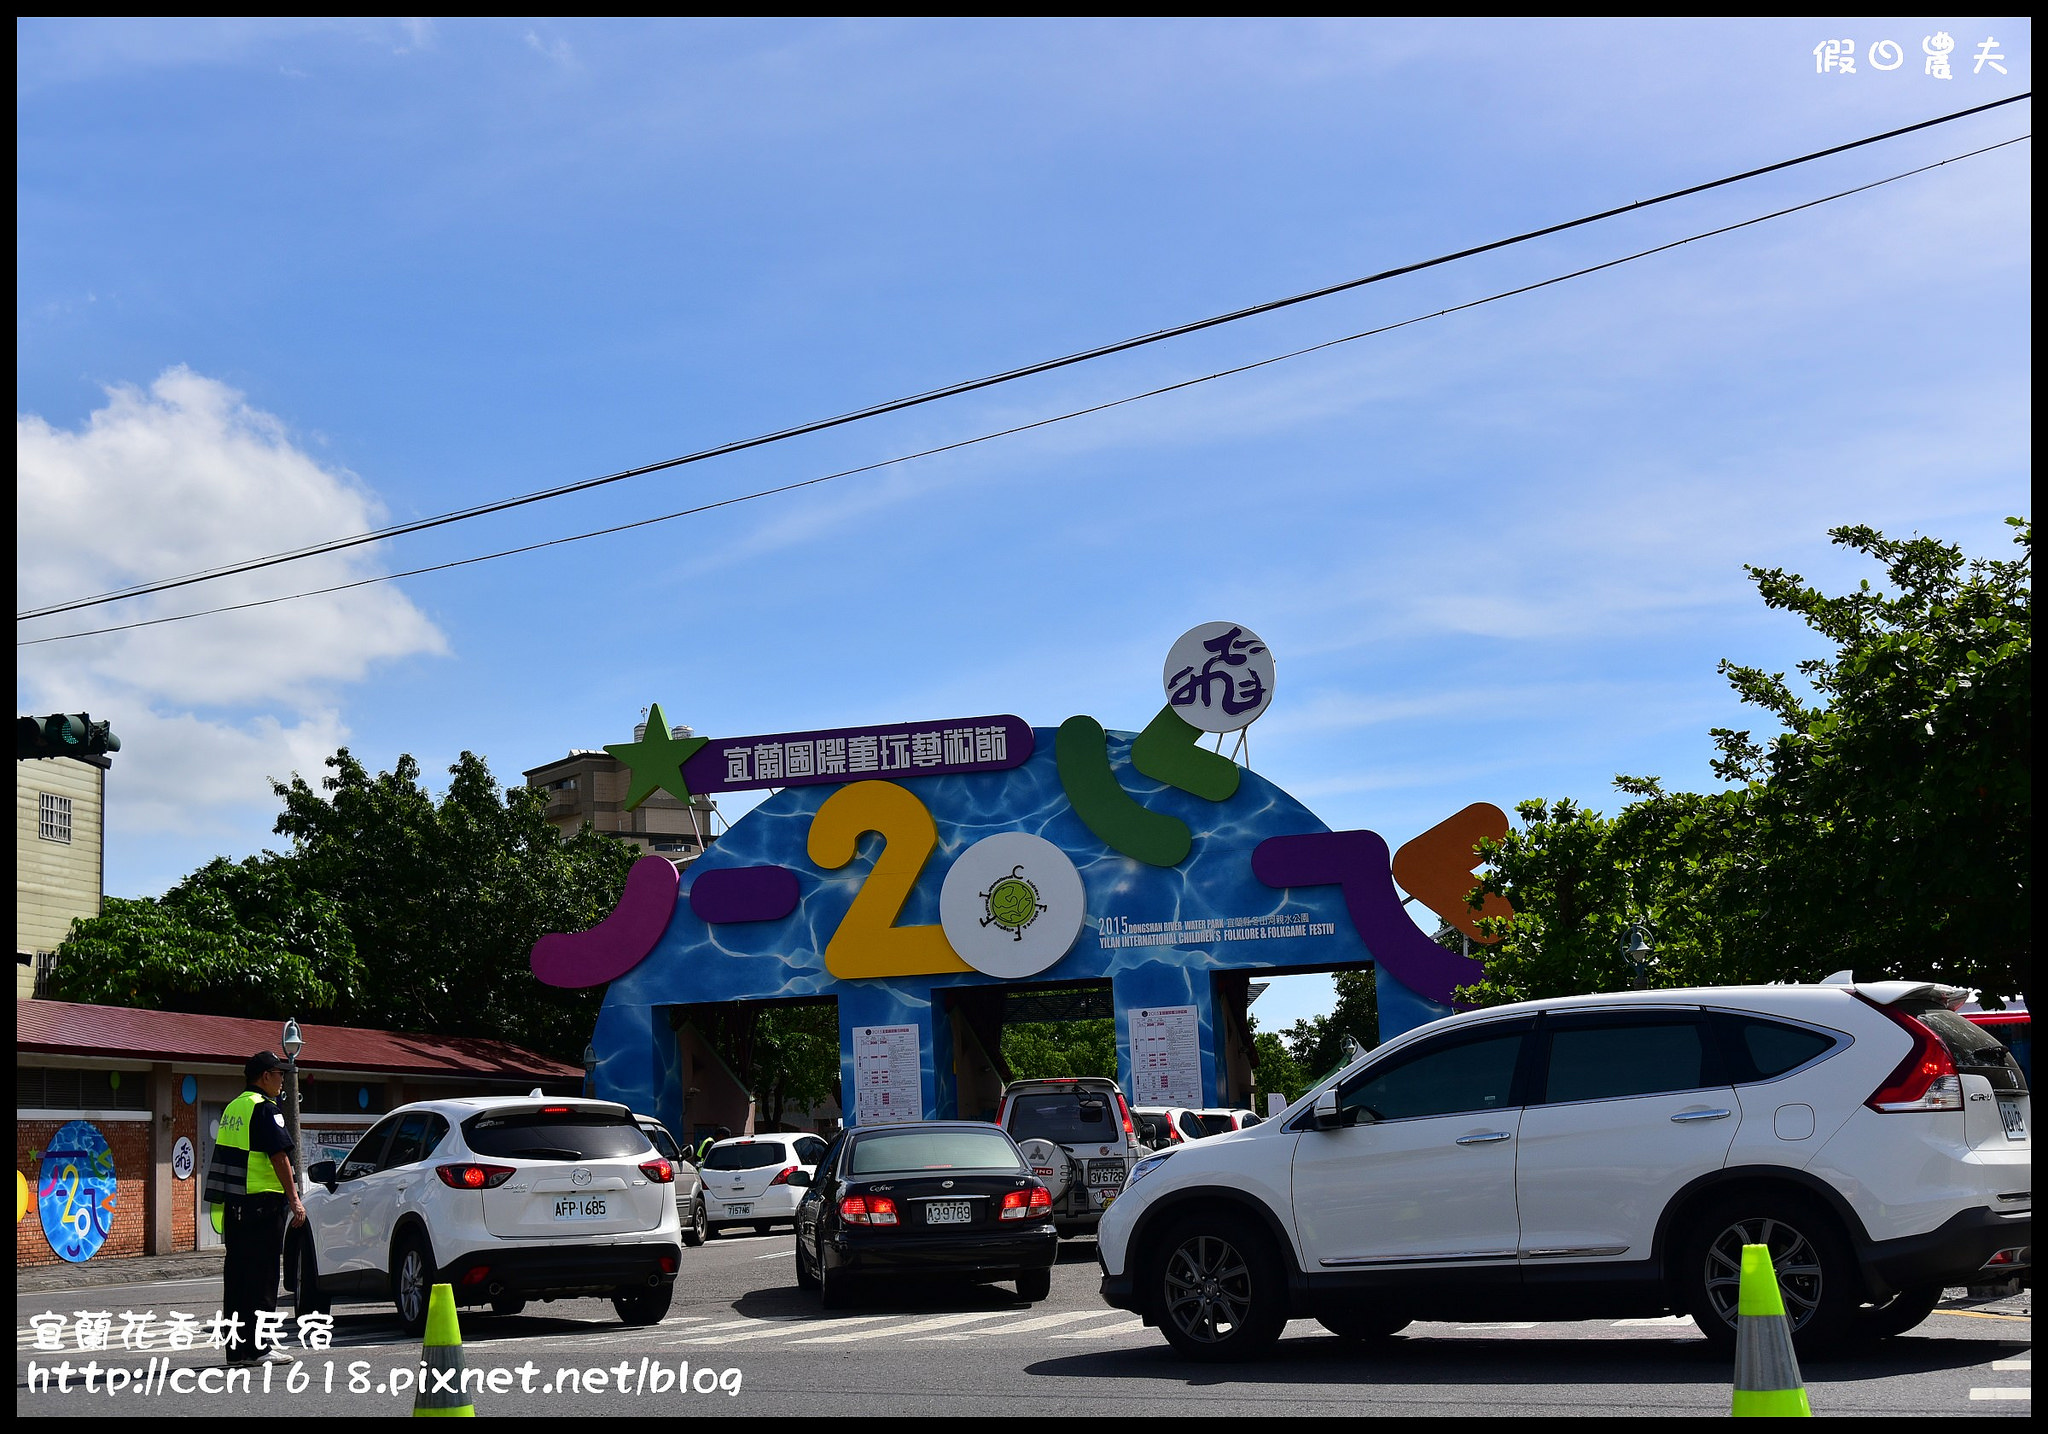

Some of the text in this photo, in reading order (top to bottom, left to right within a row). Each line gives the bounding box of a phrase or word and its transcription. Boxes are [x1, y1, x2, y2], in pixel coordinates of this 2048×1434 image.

[723, 725, 1007, 783] 宜蘭國際童玩藝術節
[1098, 916, 1128, 936] 2015
[1128, 923, 1163, 934] DONGSHAN
[1163, 921, 1183, 932] RIVER
[1184, 919, 1207, 931] WATER
[1207, 918, 1225, 929] PARK
[1099, 922, 1335, 949] YILAN INTERNATIONAL CHILDREN'S FOLKLORE & FOLKGAME FESTIV
